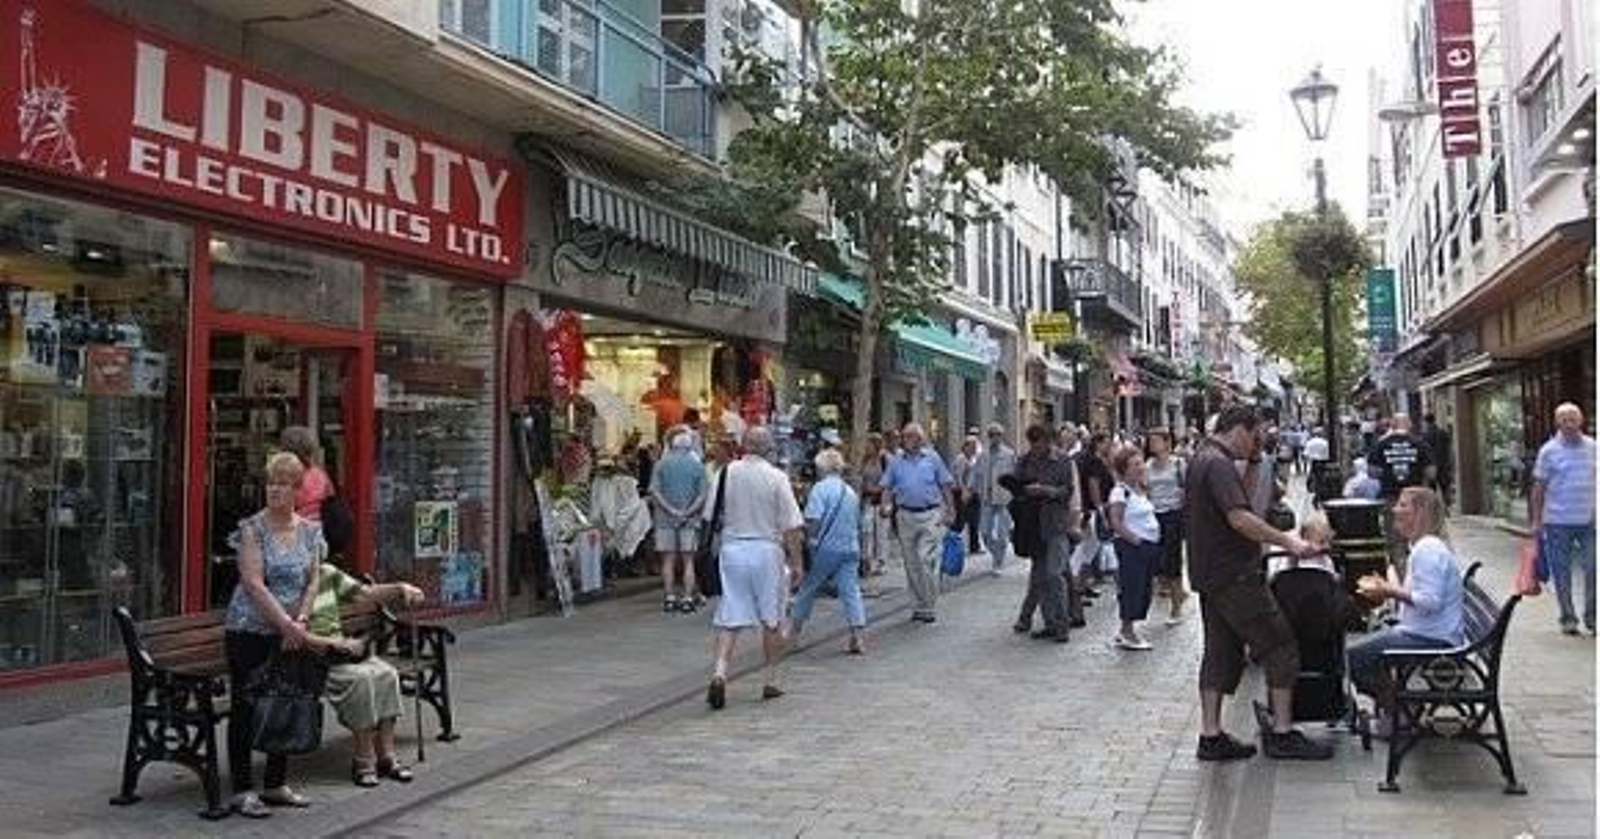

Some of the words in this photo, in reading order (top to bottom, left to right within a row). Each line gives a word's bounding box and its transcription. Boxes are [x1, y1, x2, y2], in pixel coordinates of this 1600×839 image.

[132, 41, 510, 227] LIBERTY
[1442, 47, 1478, 153] The
[128, 137, 431, 244] ELECTRONICS
[445, 222, 511, 265] LTD.
